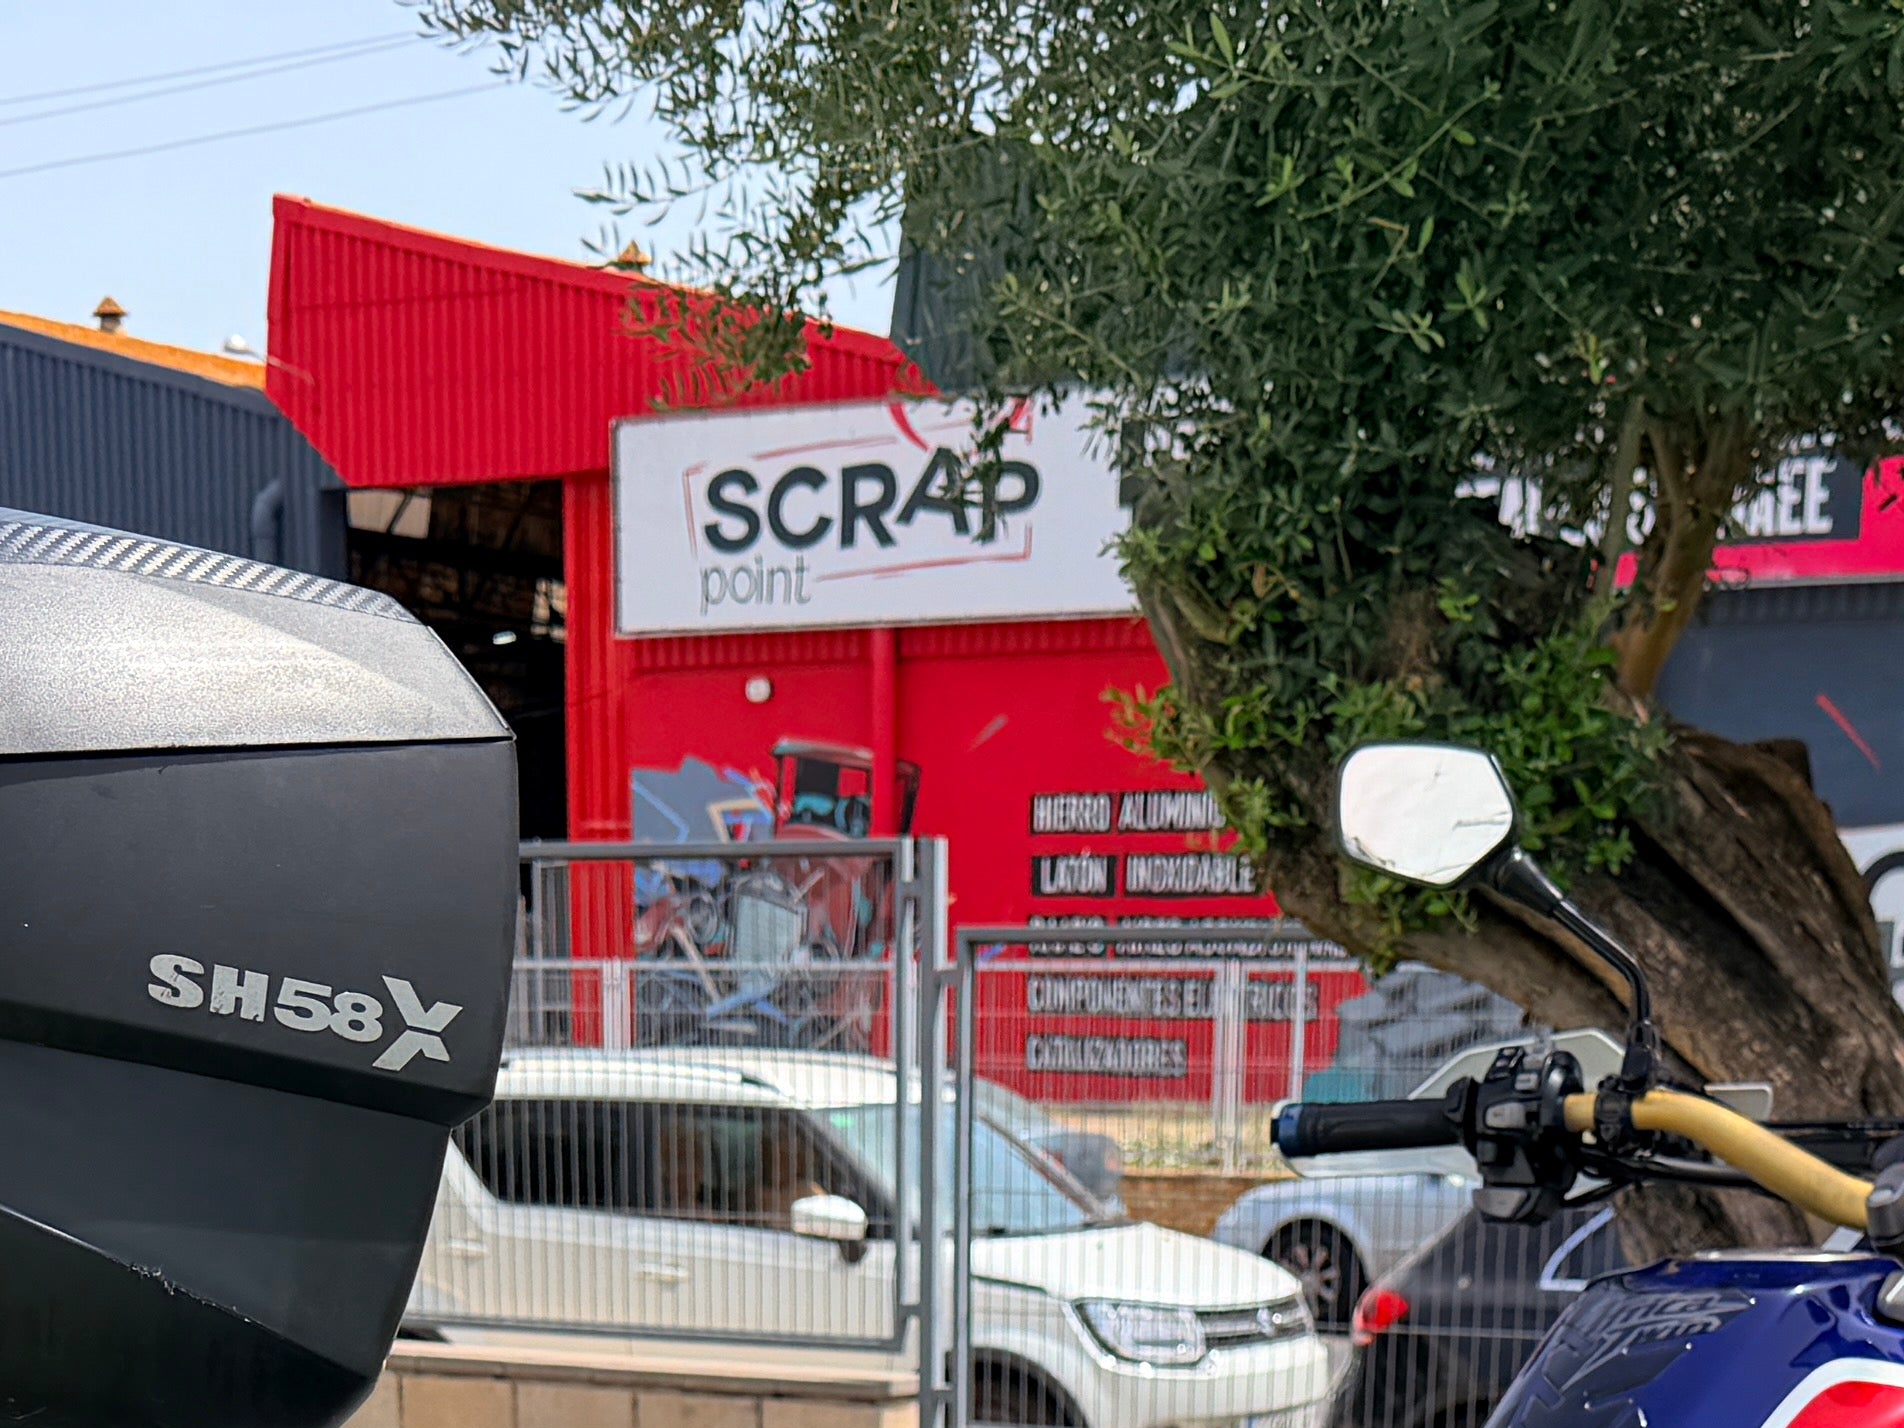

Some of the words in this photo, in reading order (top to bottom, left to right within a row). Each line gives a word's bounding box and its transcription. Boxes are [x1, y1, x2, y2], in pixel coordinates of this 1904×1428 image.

[703, 445, 1041, 551] SCRAP
[699, 554, 811, 615] point
[1033, 794, 1111, 833] HIERRO
[147, 953, 464, 1072] SH58X
